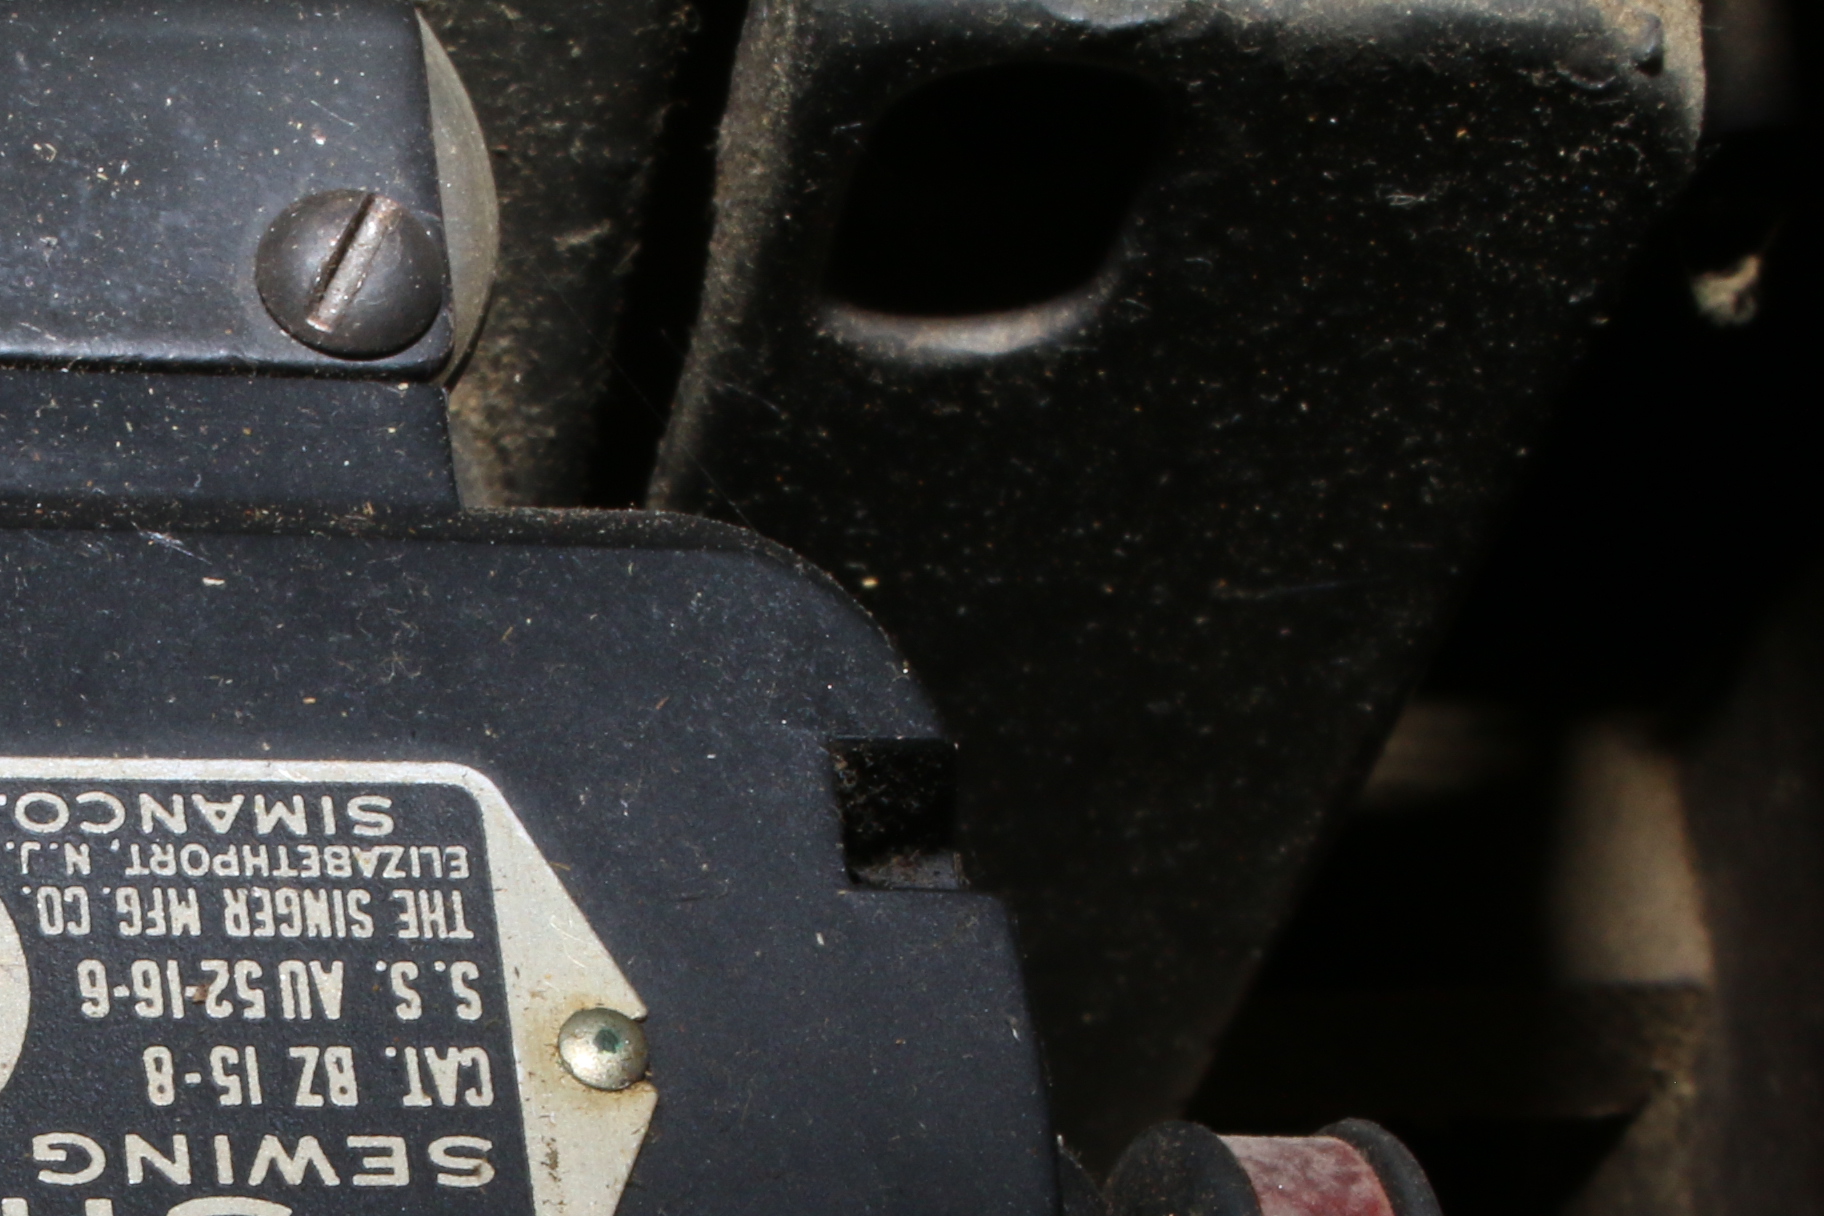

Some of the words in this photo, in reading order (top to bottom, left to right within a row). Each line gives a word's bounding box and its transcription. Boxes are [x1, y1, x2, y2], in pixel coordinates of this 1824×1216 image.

[109, 839, 470, 879] ELIZABETHPORT,
[20, 885, 92, 936] CO.
[102, 886, 201, 937] MFG.
[223, 887, 374, 939] SINGER
[392, 888, 475, 940] THE
[141, 1045, 262, 1106] 15-8
[288, 1045, 359, 1107] BZ
[384, 1045, 495, 1107] CAT.
[31, 1132, 496, 1187] SEWING
